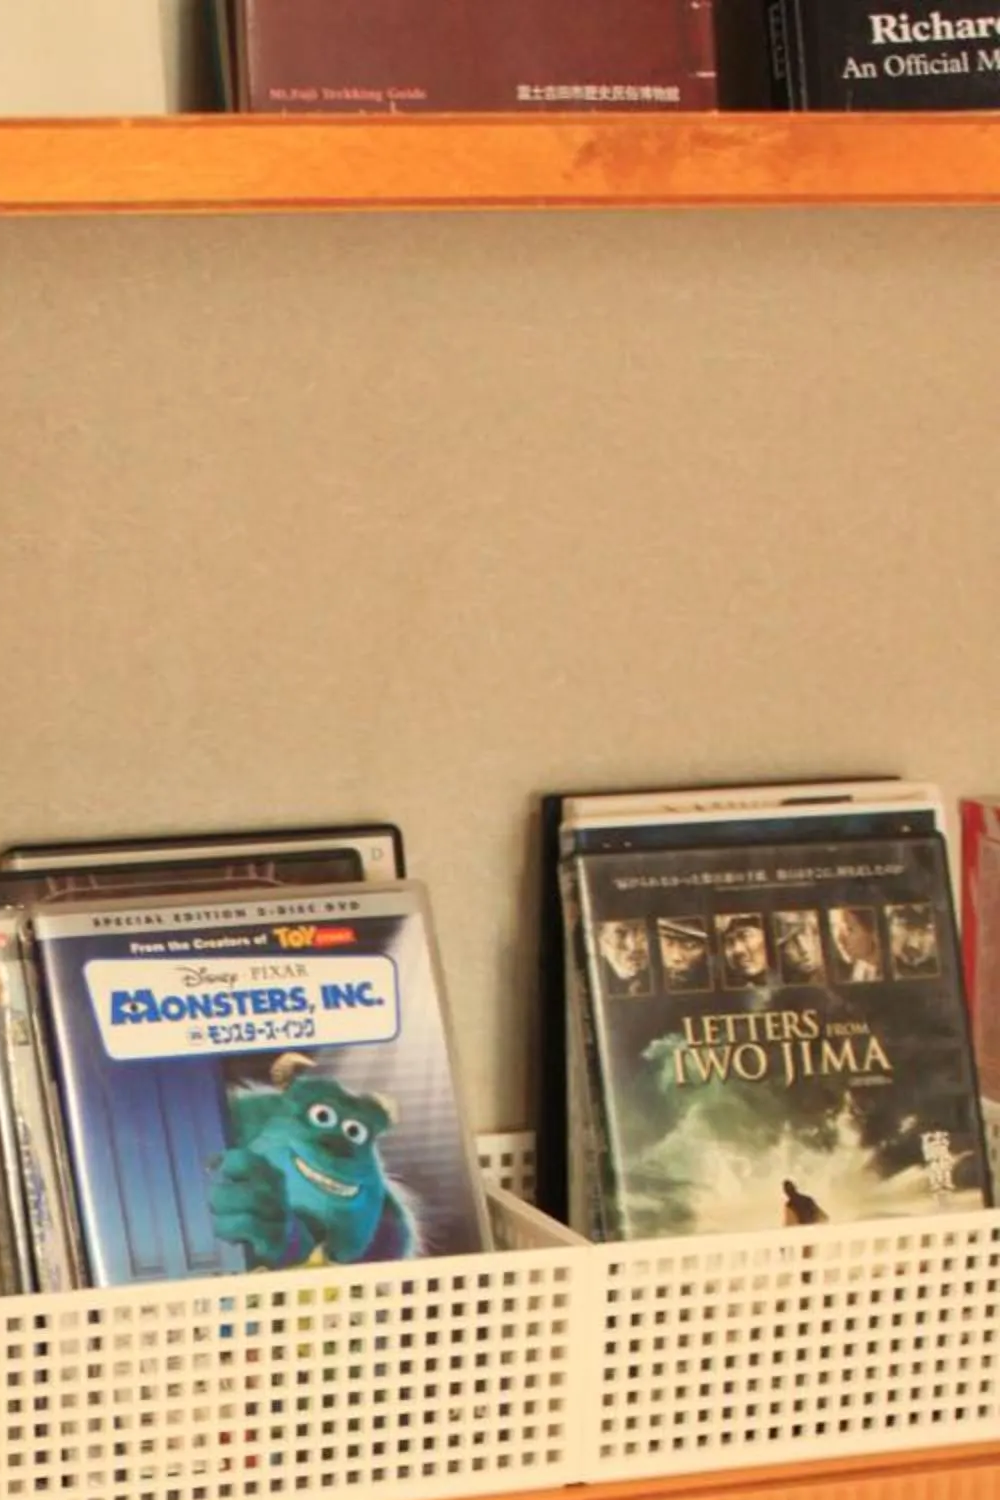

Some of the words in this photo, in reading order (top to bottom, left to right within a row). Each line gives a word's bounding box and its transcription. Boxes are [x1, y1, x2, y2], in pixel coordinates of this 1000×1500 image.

[842, 56, 877, 79] An
[884, 51, 970, 77] Official
[386, 86, 428, 99] Guide
[92, 915, 164, 929] SPECIAL
[173, 909, 248, 924] EDITION
[325, 900, 361, 913] DVD
[129, 941, 165, 954] From
[167, 938, 190, 952] the
[193, 936, 251, 951] Creators
[253, 933, 268, 946] of
[272, 925, 317, 948] TOY
[250, 964, 308, 982] PIXAR
[320, 982, 385, 1010] INC.
[682, 1009, 820, 1046] LETTERS
[826, 1022, 871, 1038] FROM
[673, 1043, 768, 1085] IWO
[781, 1036, 894, 1087] JIMA
